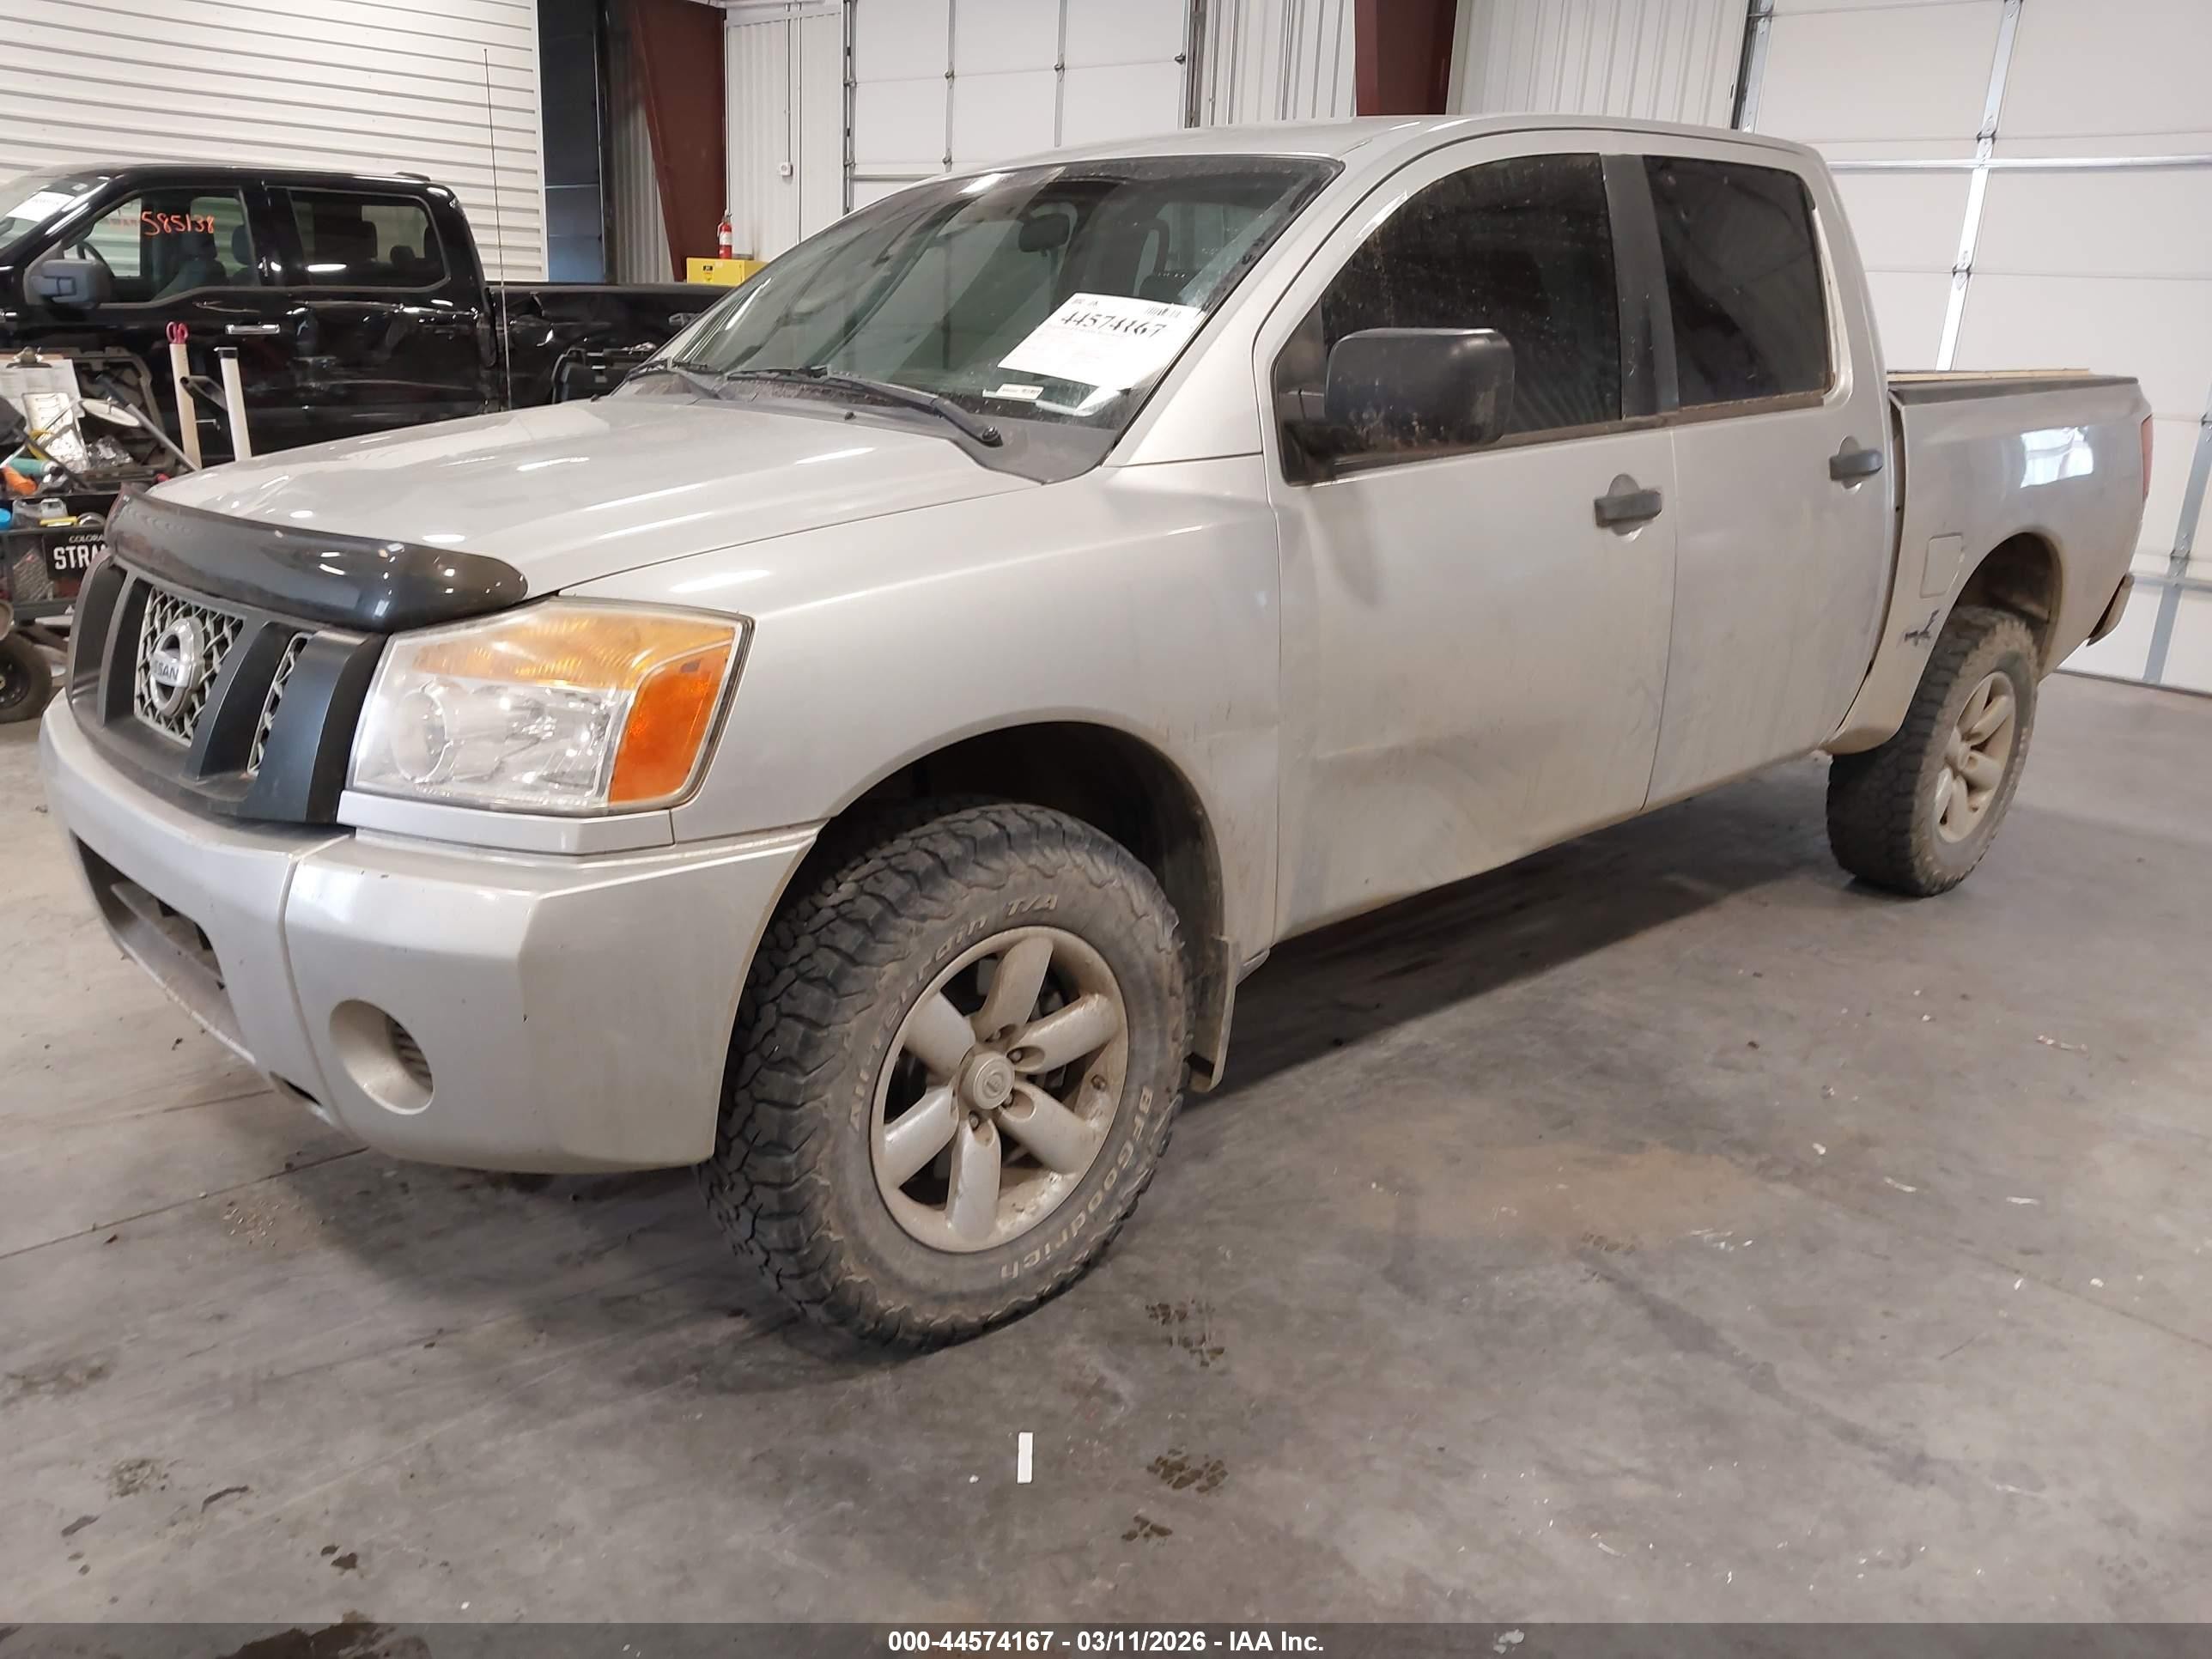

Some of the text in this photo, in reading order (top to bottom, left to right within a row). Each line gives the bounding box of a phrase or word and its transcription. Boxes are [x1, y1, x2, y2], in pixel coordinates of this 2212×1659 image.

[142, 210, 215, 237] 585138
[1060, 311, 1168, 337] 44574167
[53, 544, 106, 570] STRA
[1008, 894, 1058, 916] T/A
